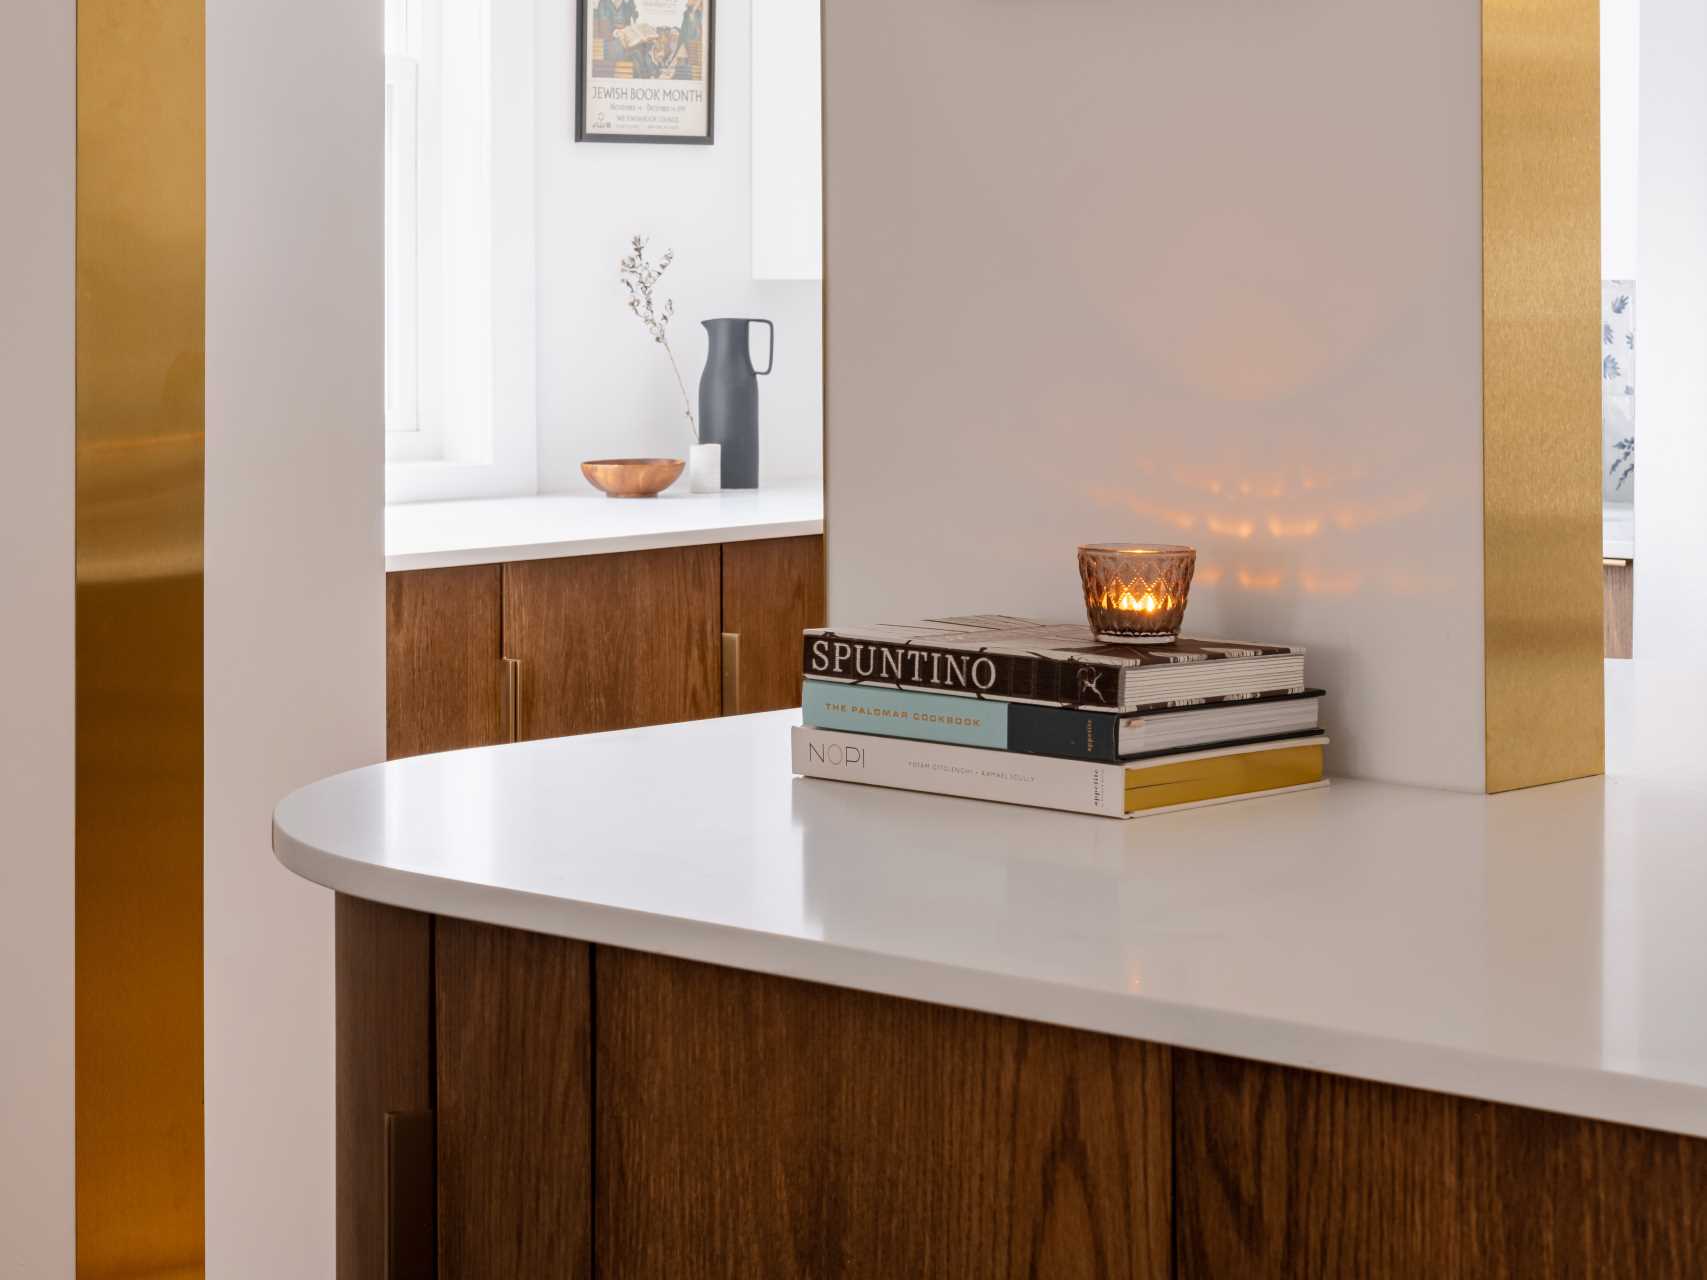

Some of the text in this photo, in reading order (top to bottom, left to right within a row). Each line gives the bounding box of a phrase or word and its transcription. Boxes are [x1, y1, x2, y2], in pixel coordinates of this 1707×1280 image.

[592, 86, 703, 104] JEWISH BOOK MONTH
[811, 639, 996, 690] SPUNTINO
[825, 702, 982, 728] THE PALOMAR COOKBOOK
[808, 742, 865, 769] NOPI
